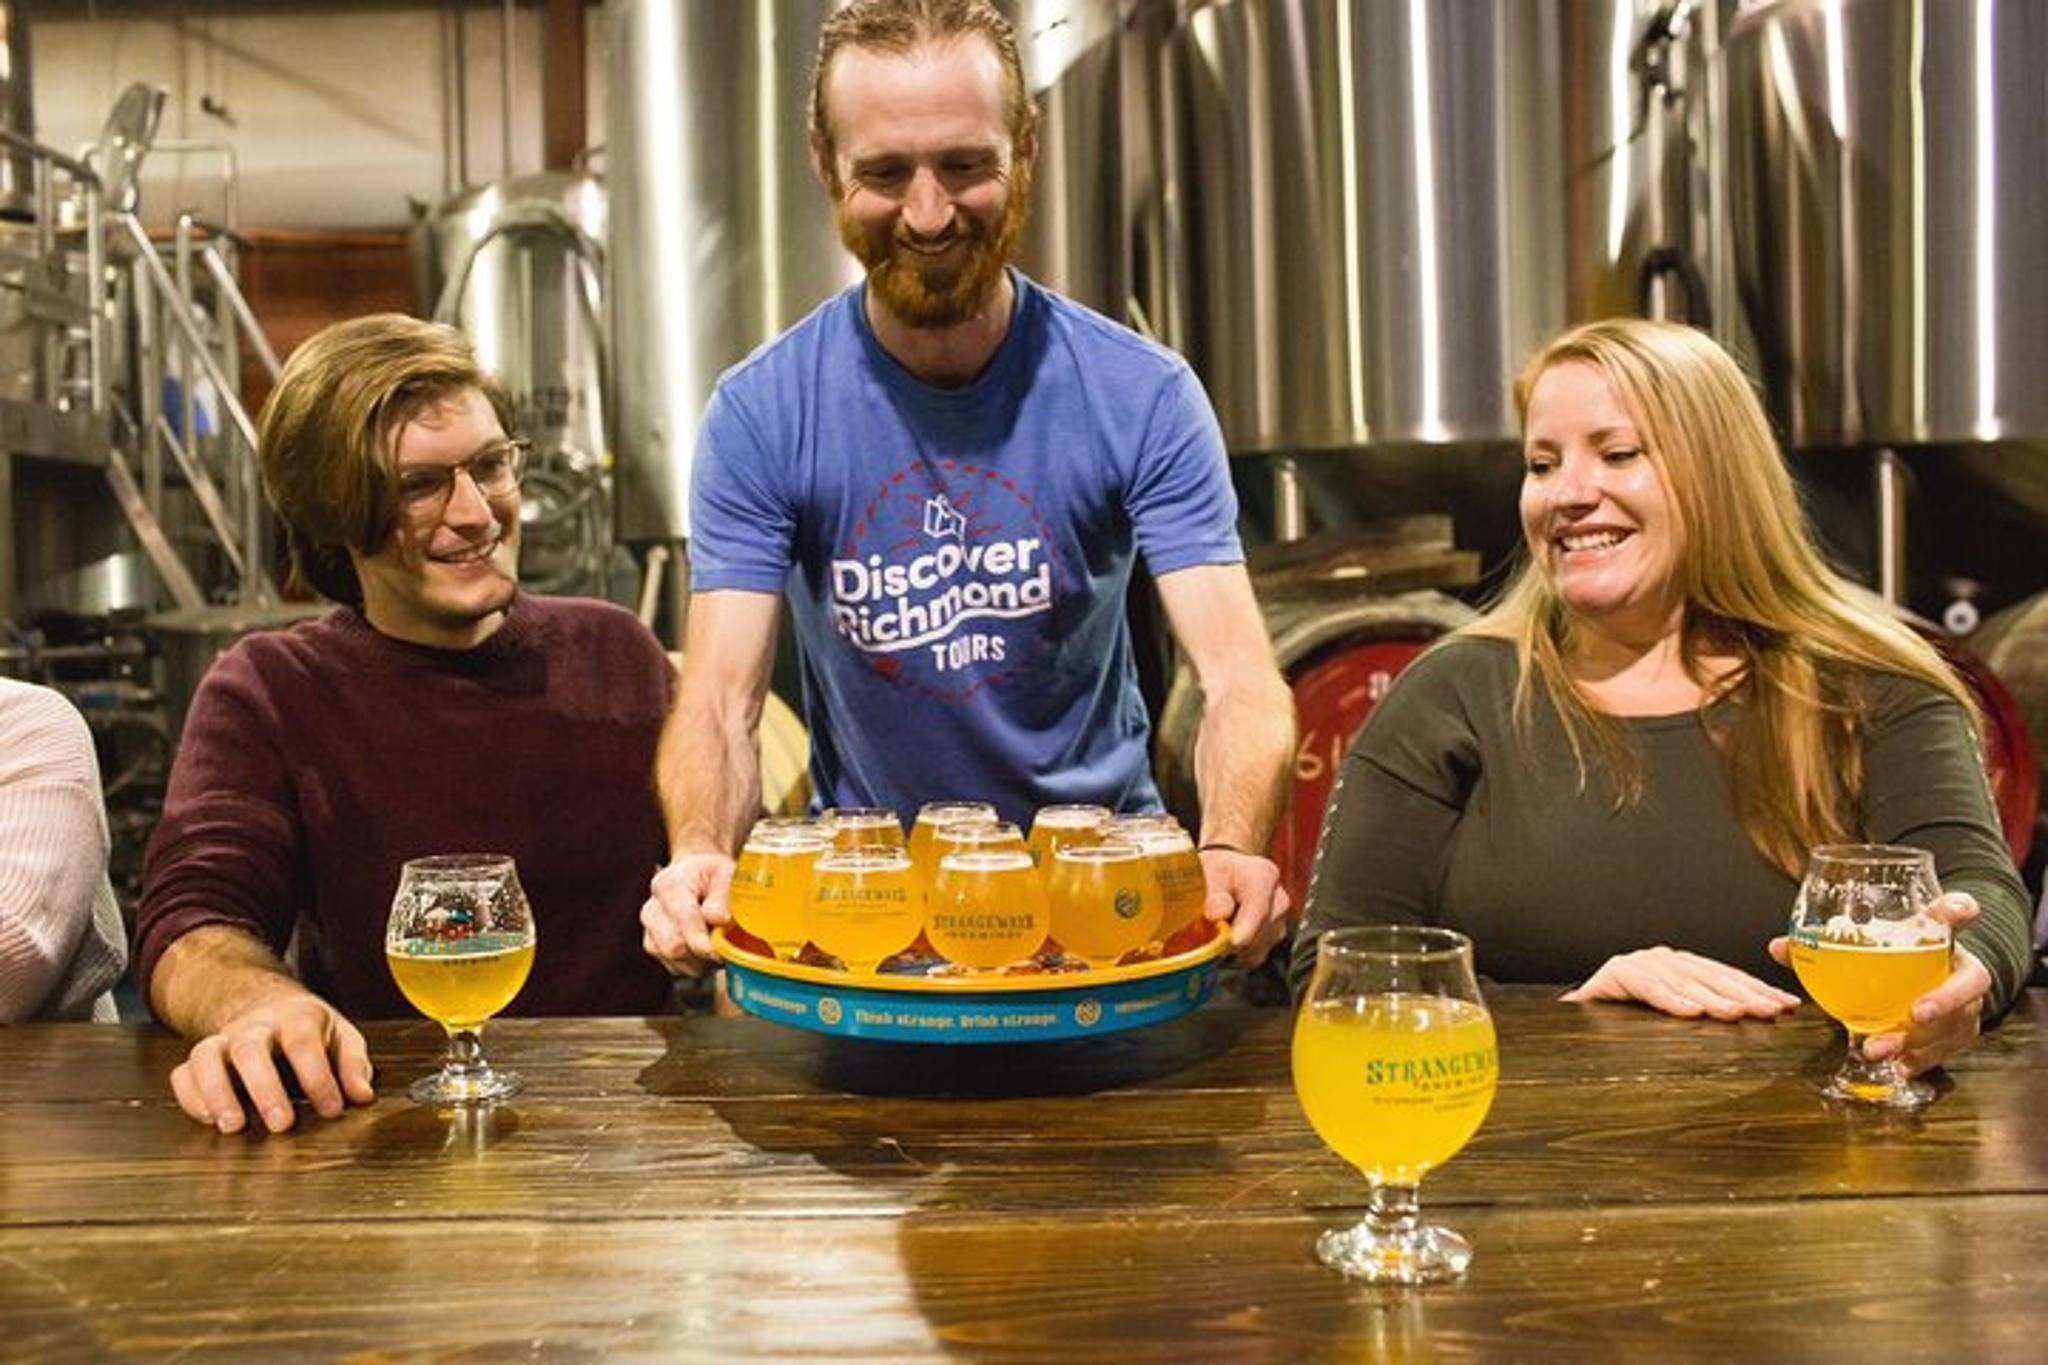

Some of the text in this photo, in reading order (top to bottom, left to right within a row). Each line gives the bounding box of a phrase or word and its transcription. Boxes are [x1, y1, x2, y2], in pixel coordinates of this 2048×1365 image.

[831, 537, 1040, 602] Discover
[833, 563, 1050, 642] Richmond
[932, 634, 1006, 672] TOURS
[933, 913, 1034, 930] STRANGEWAYS
